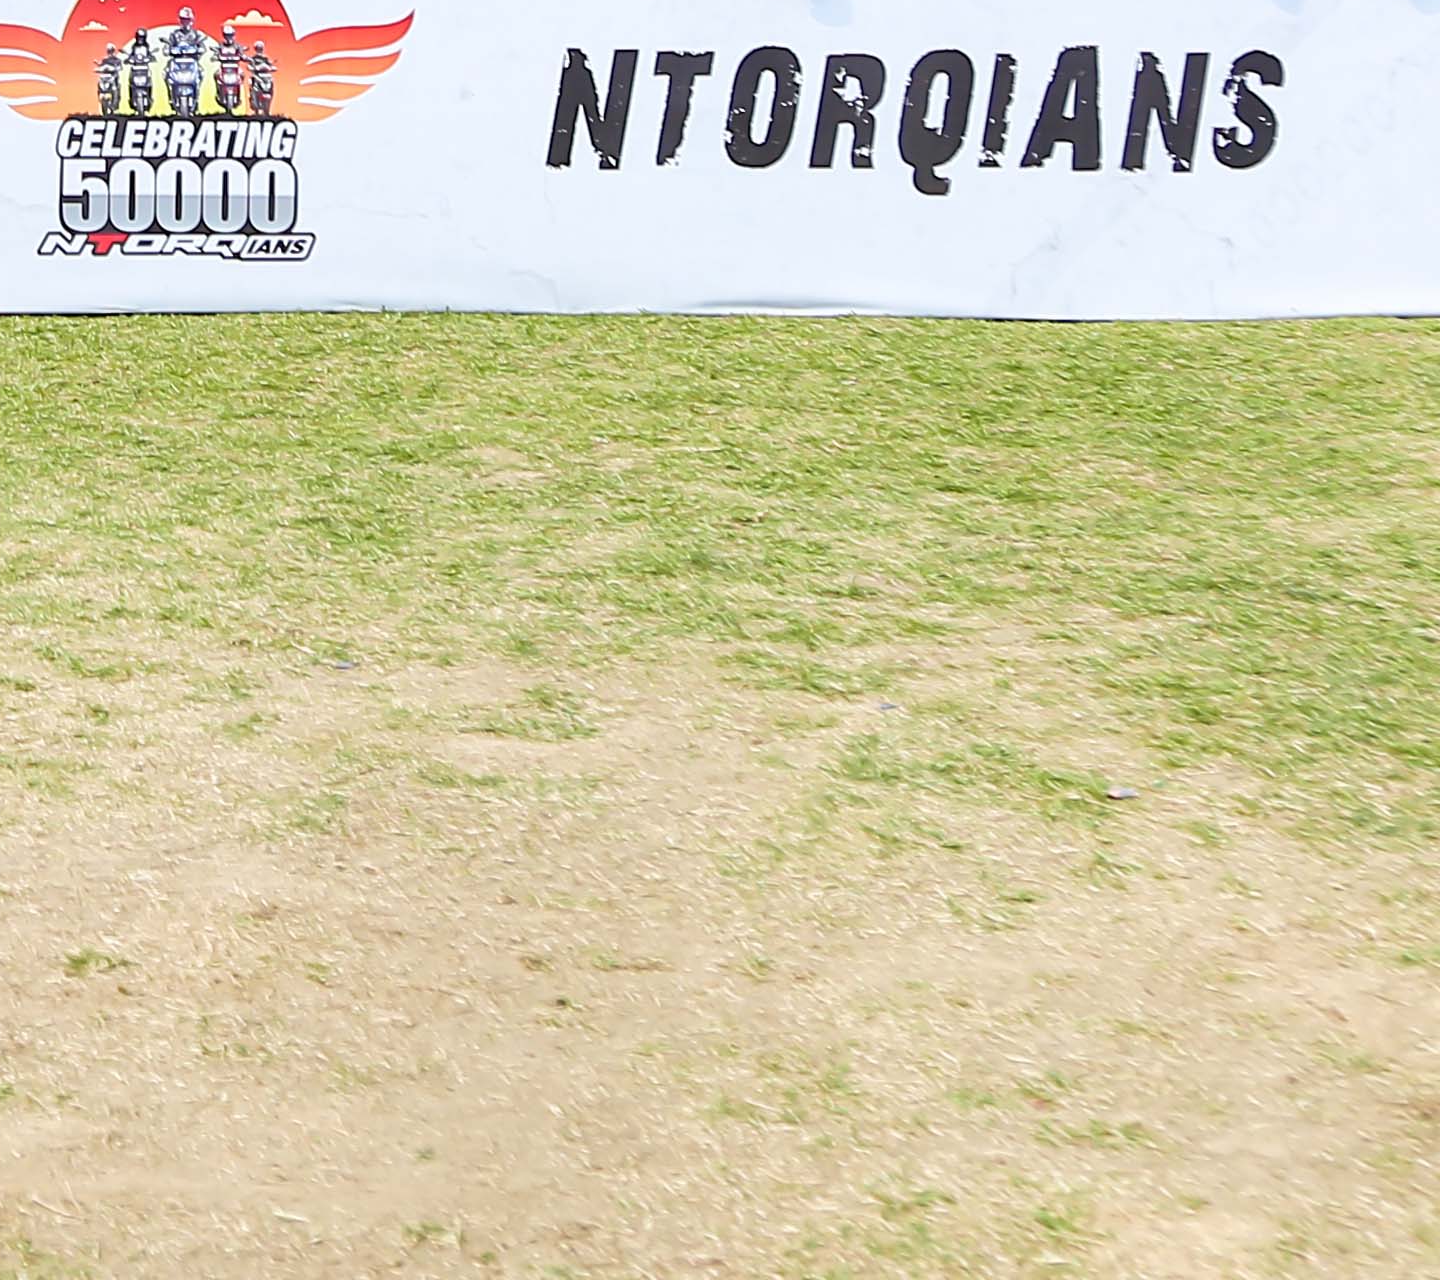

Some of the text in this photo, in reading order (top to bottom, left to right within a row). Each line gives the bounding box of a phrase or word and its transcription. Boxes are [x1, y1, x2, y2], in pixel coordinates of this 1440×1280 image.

[58, 120, 298, 159] CELEBRATING
[545, 45, 1285, 195] NTORQIANS
[61, 158, 296, 233] 50000
